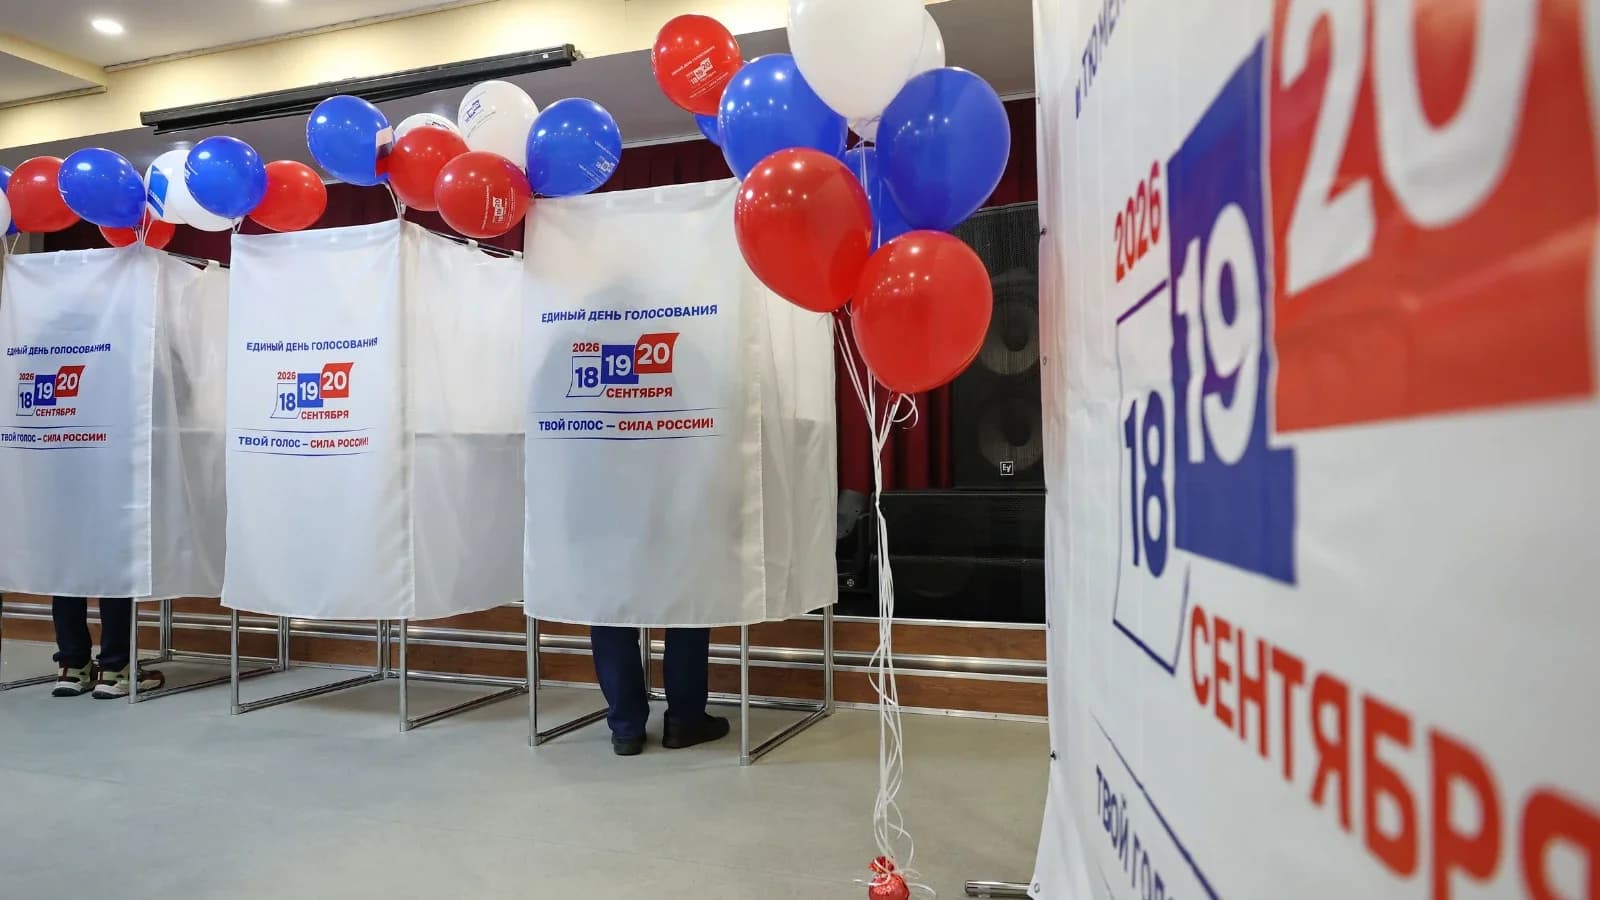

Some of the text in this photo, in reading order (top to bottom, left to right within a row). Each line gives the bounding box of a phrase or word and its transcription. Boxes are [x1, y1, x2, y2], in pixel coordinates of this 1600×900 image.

[1082, 0, 1120, 97] ТЮМЕ
[1114, 160, 1161, 283] 2026
[1124, 0, 1540, 578] 18 19 20
[541, 304, 718, 323] ЕДИНЫЙ ДЕНЬ ГОЛОСОВАНИЯ
[28, 347, 49, 356] ДЕНЬ
[50, 343, 111, 355] ГОЛОСОВАНИЯ
[246, 337, 378, 352] ЕДИНЫЙ ДЕНЬ ГОЛОСОВАНИЯ
[572, 343, 600, 352] 2026
[575, 342, 670, 388] 18 19 20
[277, 371, 296, 380] 2026
[20, 373, 79, 408] 18 19 20
[279, 371, 347, 411] 18 19 20
[606, 387, 673, 399] СЕНТЯБРЯ
[36, 408, 76, 416] СЕНТЯБРЯ
[301, 410, 349, 420] СЕНТЯБРЯ
[539, 418, 566, 431] ТВОЙ
[567, 420, 604, 431] ГОЛОС
[618, 420, 654, 431] СИЛА
[657, 418, 714, 430] РОССИИ!
[1, 432, 17, 441] ТВОЙ
[17, 434, 36, 442] ГОЛОС
[43, 434, 60, 442] СИЛА
[63, 433, 107, 442] РОССИИ!
[238, 436, 269, 447] ТВОЙ
[271, 438, 301, 448] ГОЛОС
[310, 439, 336, 448] СИЛА
[337, 437, 369, 448] РОССИИ!
[1096, 764, 1129, 873] ТВОЙ
